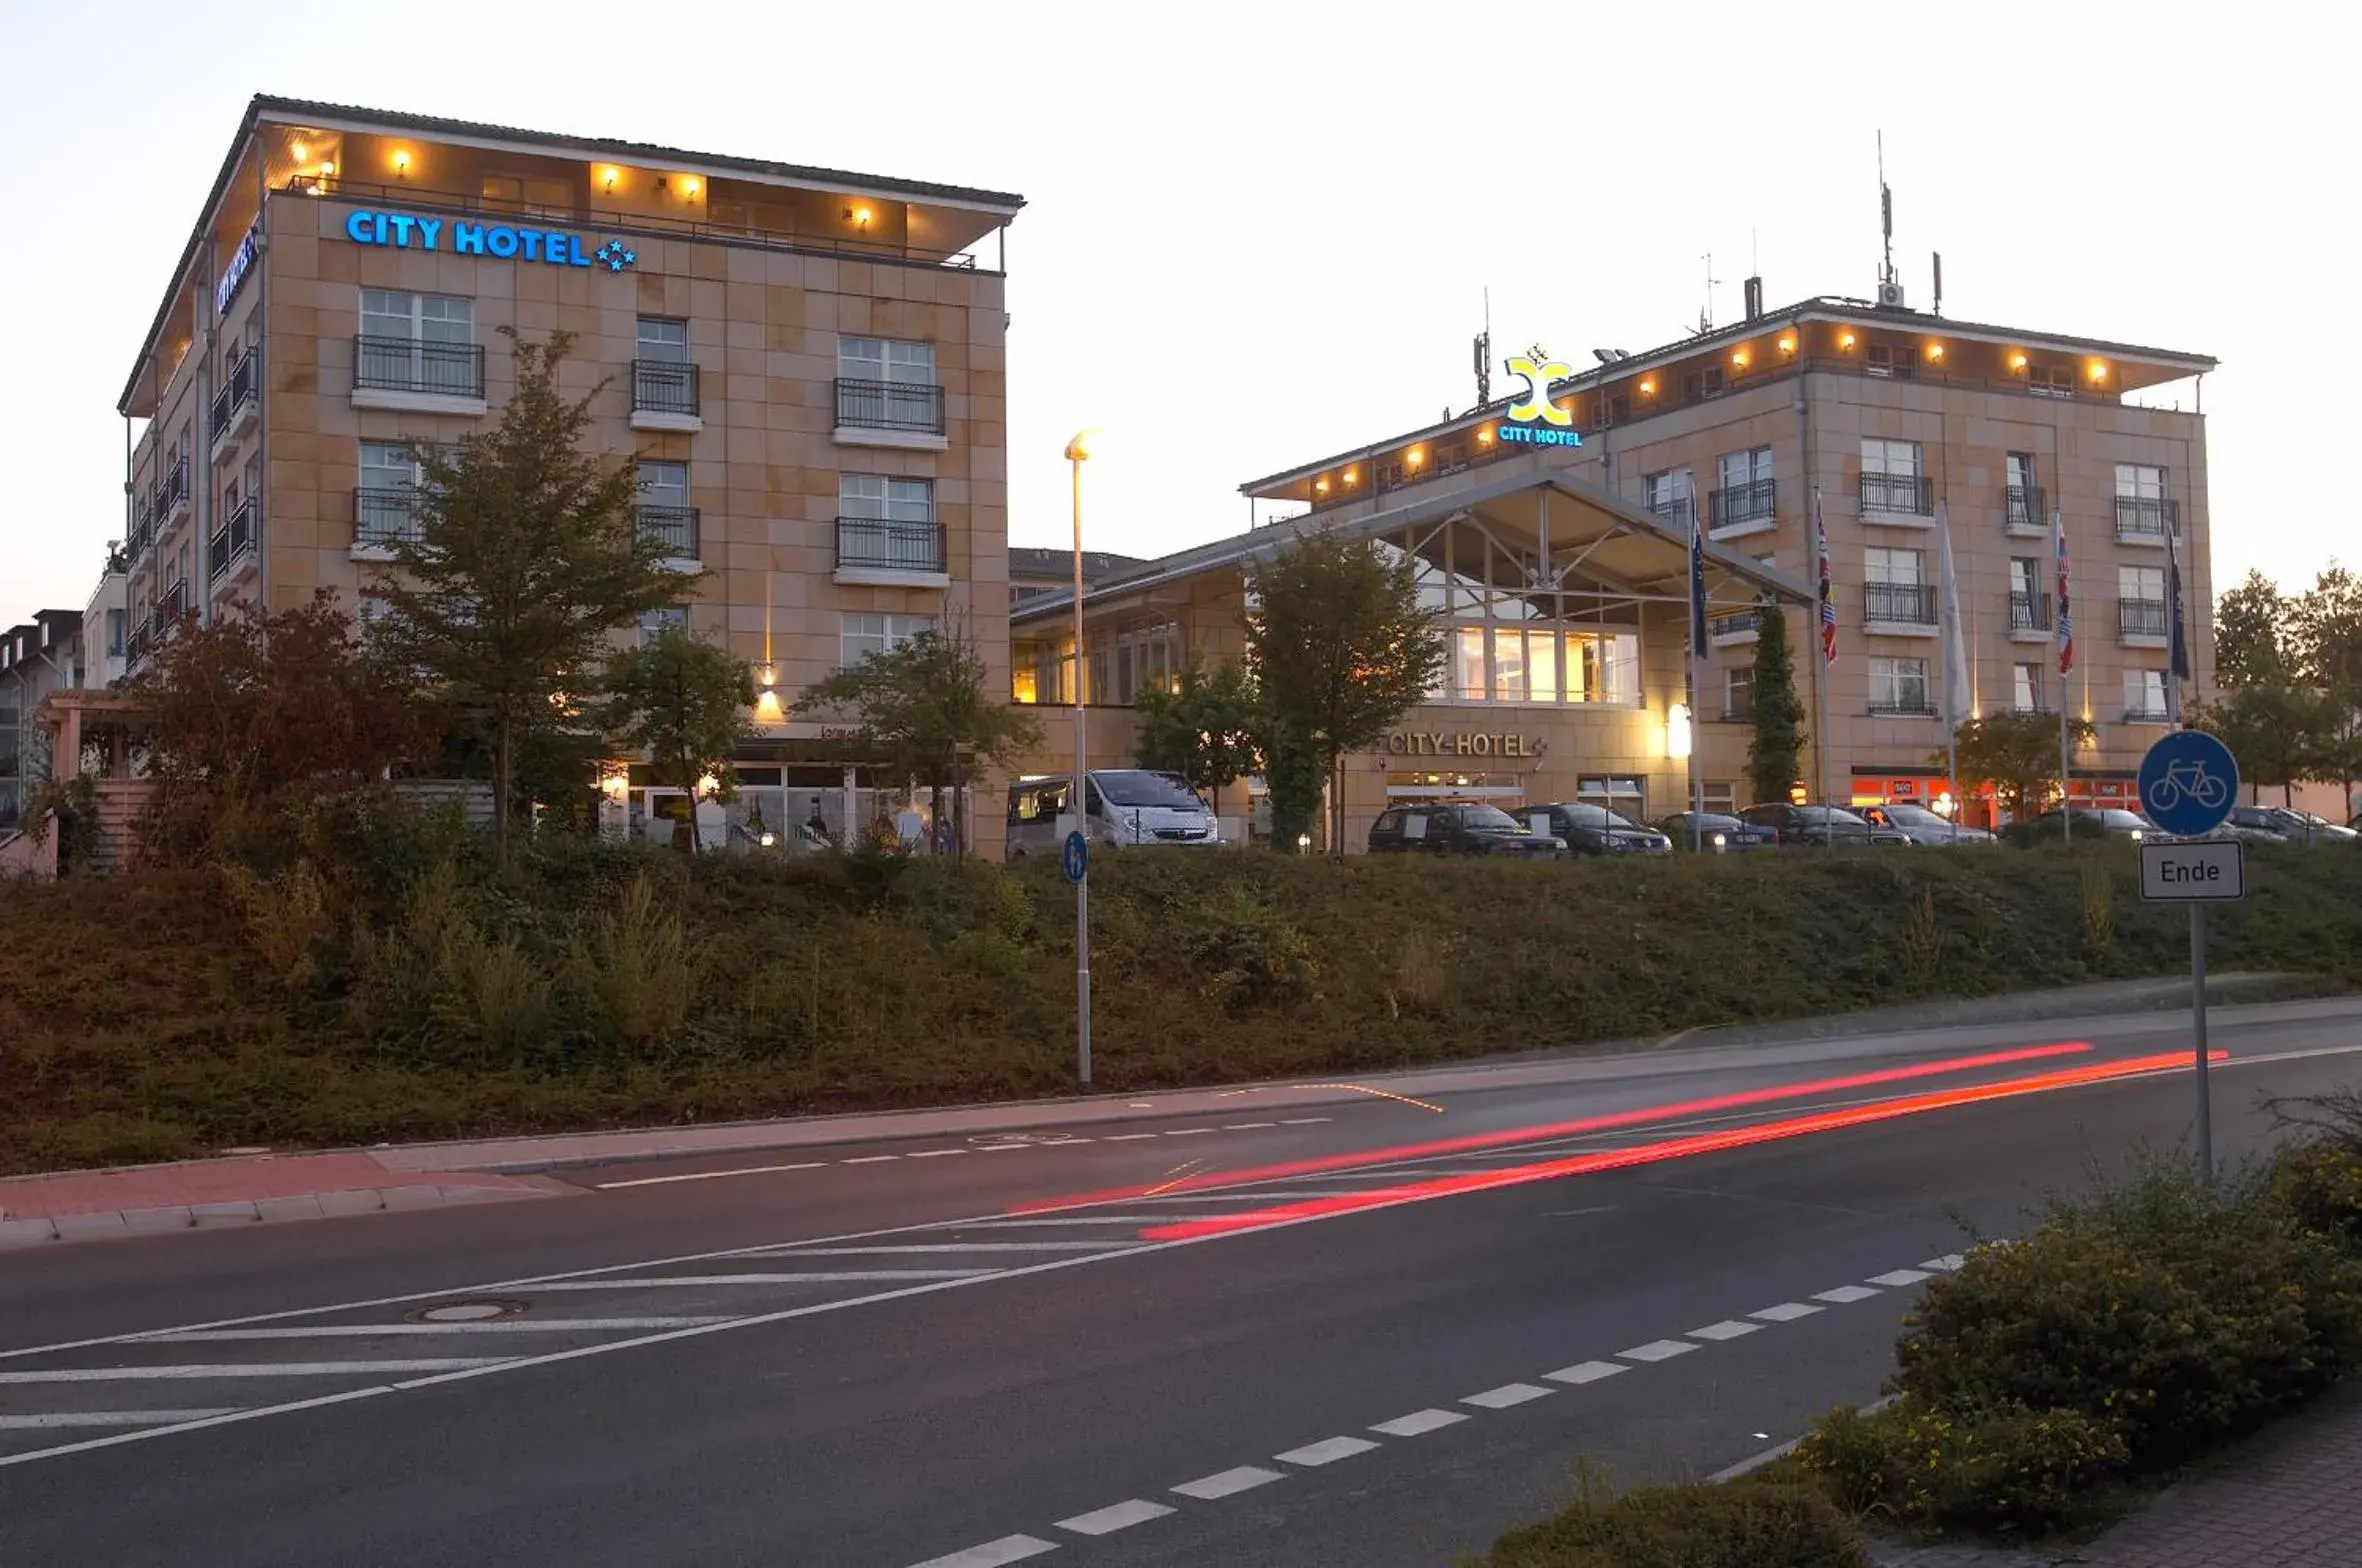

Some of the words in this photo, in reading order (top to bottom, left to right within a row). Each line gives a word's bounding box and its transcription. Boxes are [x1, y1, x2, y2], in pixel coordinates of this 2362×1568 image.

[346, 210, 443, 250] CITY
[453, 221, 593, 268] HOTEL
[1499, 426, 1531, 442] CITY
[1534, 429, 1582, 447] HOTEL
[2160, 860, 2220, 883] Ende
